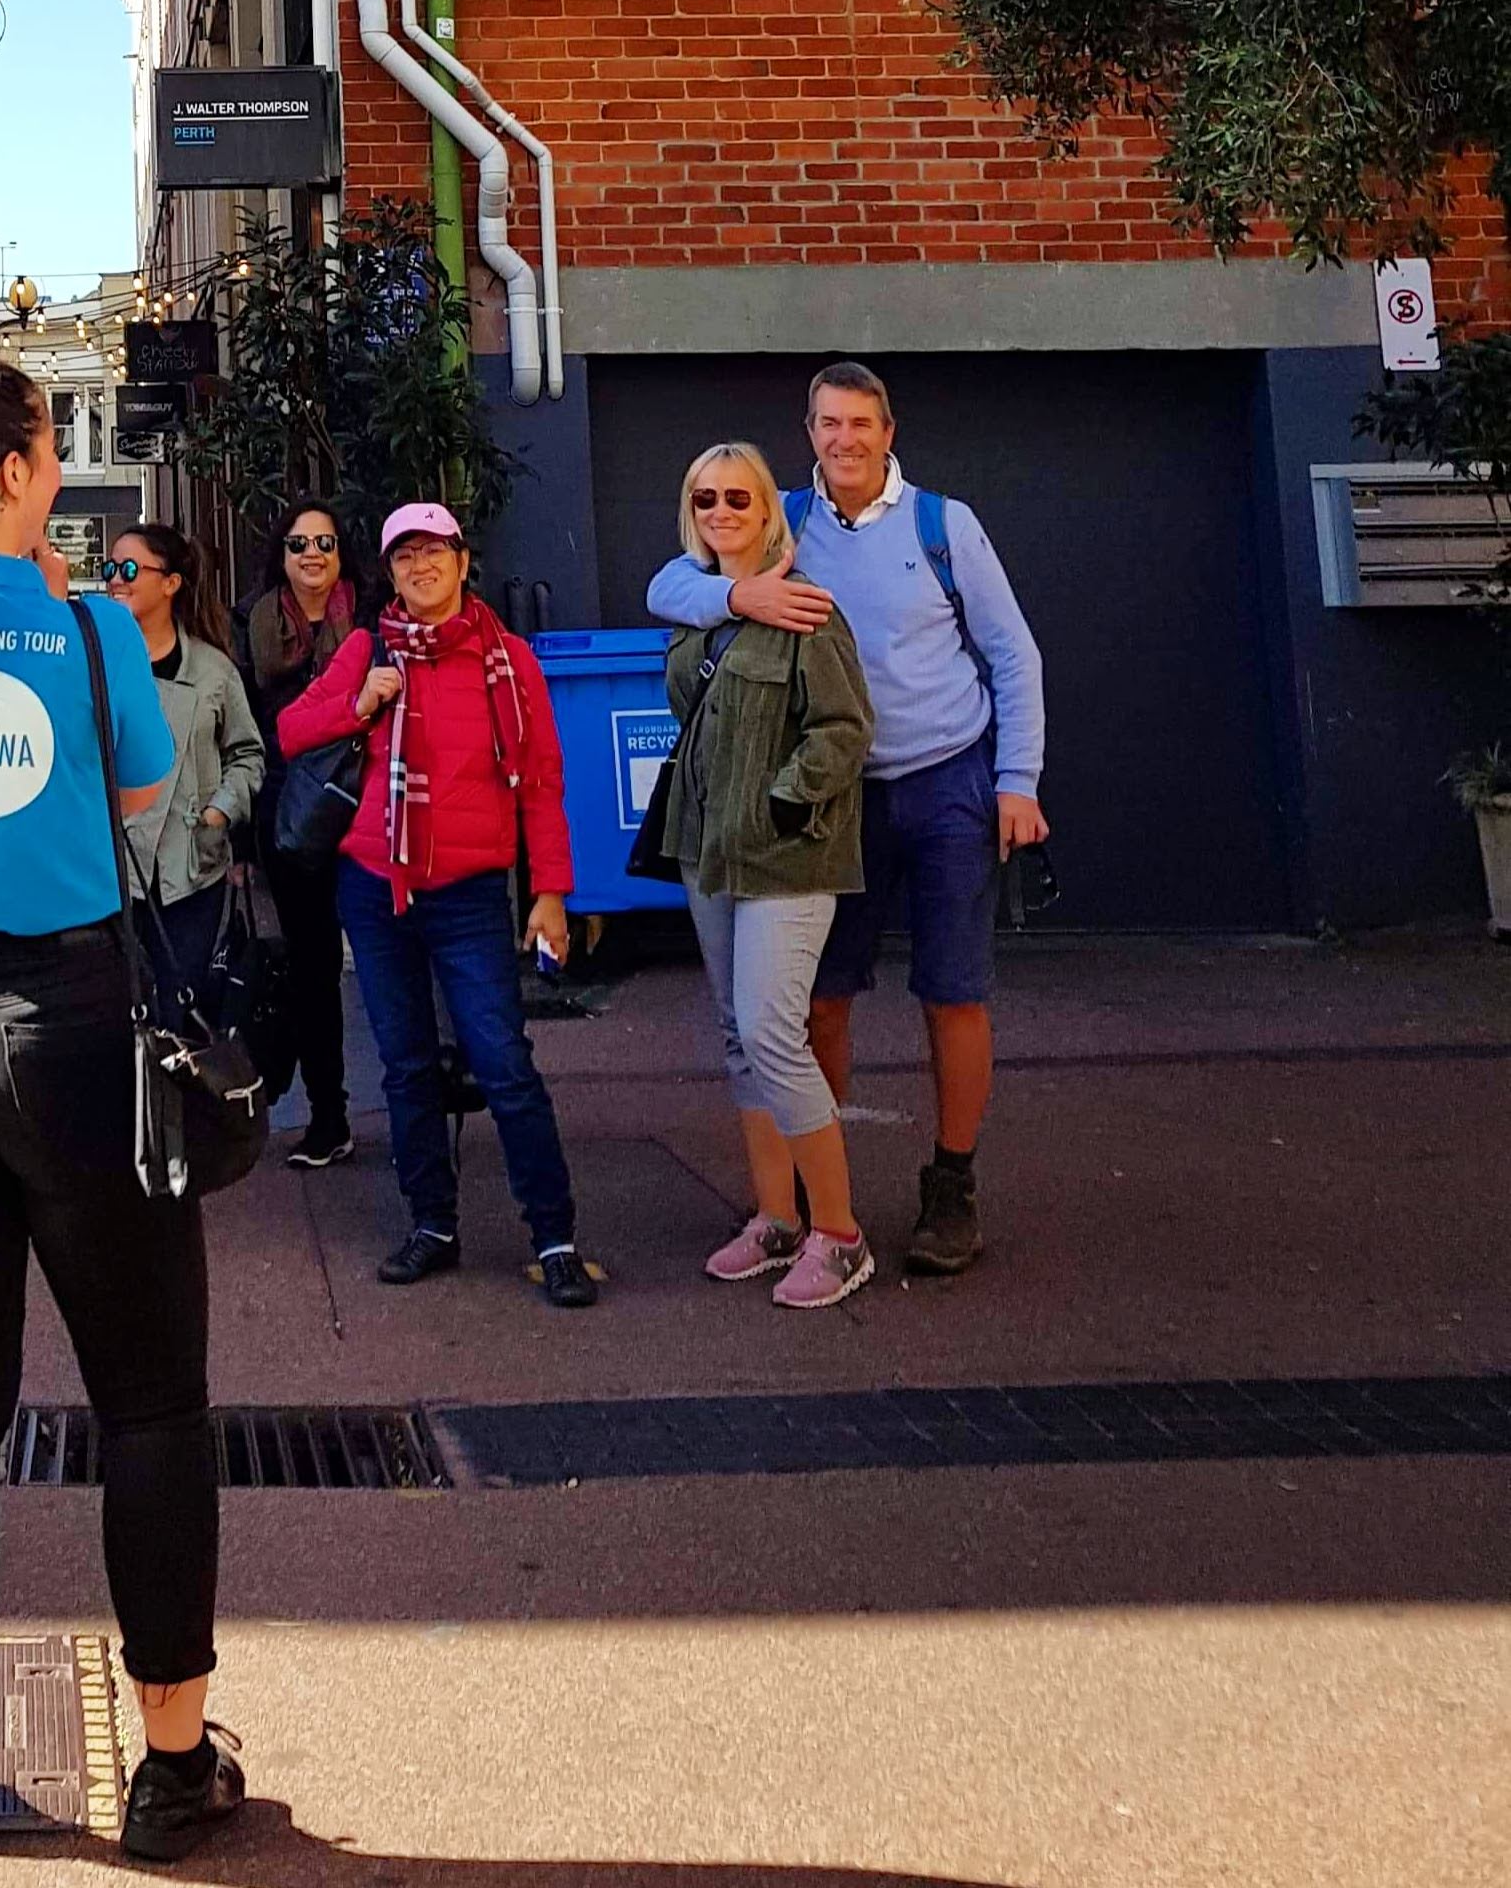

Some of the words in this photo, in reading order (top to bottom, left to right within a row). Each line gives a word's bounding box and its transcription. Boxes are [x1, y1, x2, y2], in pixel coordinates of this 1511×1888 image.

[173, 102, 184, 115] J.
[186, 102, 236, 115] WALTER
[237, 100, 309, 113] THOMPSON
[174, 126, 215, 139] PERTH
[23, 630, 67, 655] TOUR
